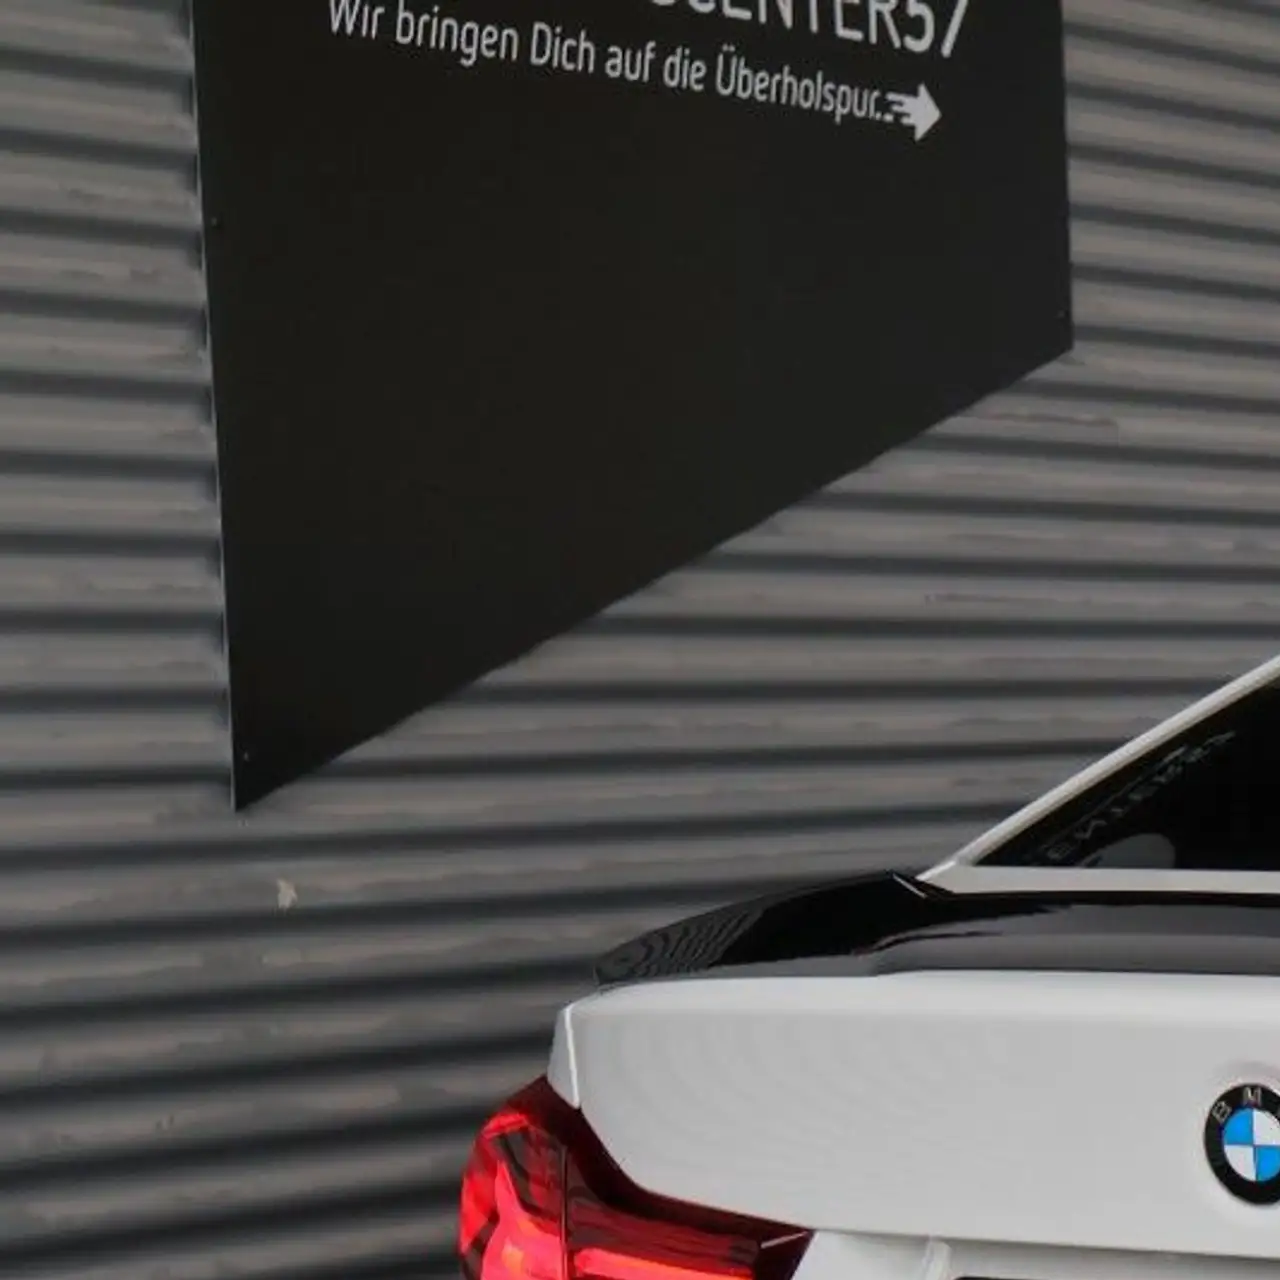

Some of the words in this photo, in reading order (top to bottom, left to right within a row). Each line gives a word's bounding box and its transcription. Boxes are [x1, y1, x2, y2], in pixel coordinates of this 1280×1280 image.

[329, 0, 385, 39] Wir
[395, 0, 519, 67] bringen
[529, 21, 596, 74] Dich
[604, 40, 656, 83] auf
[662, 45, 707, 92] die
